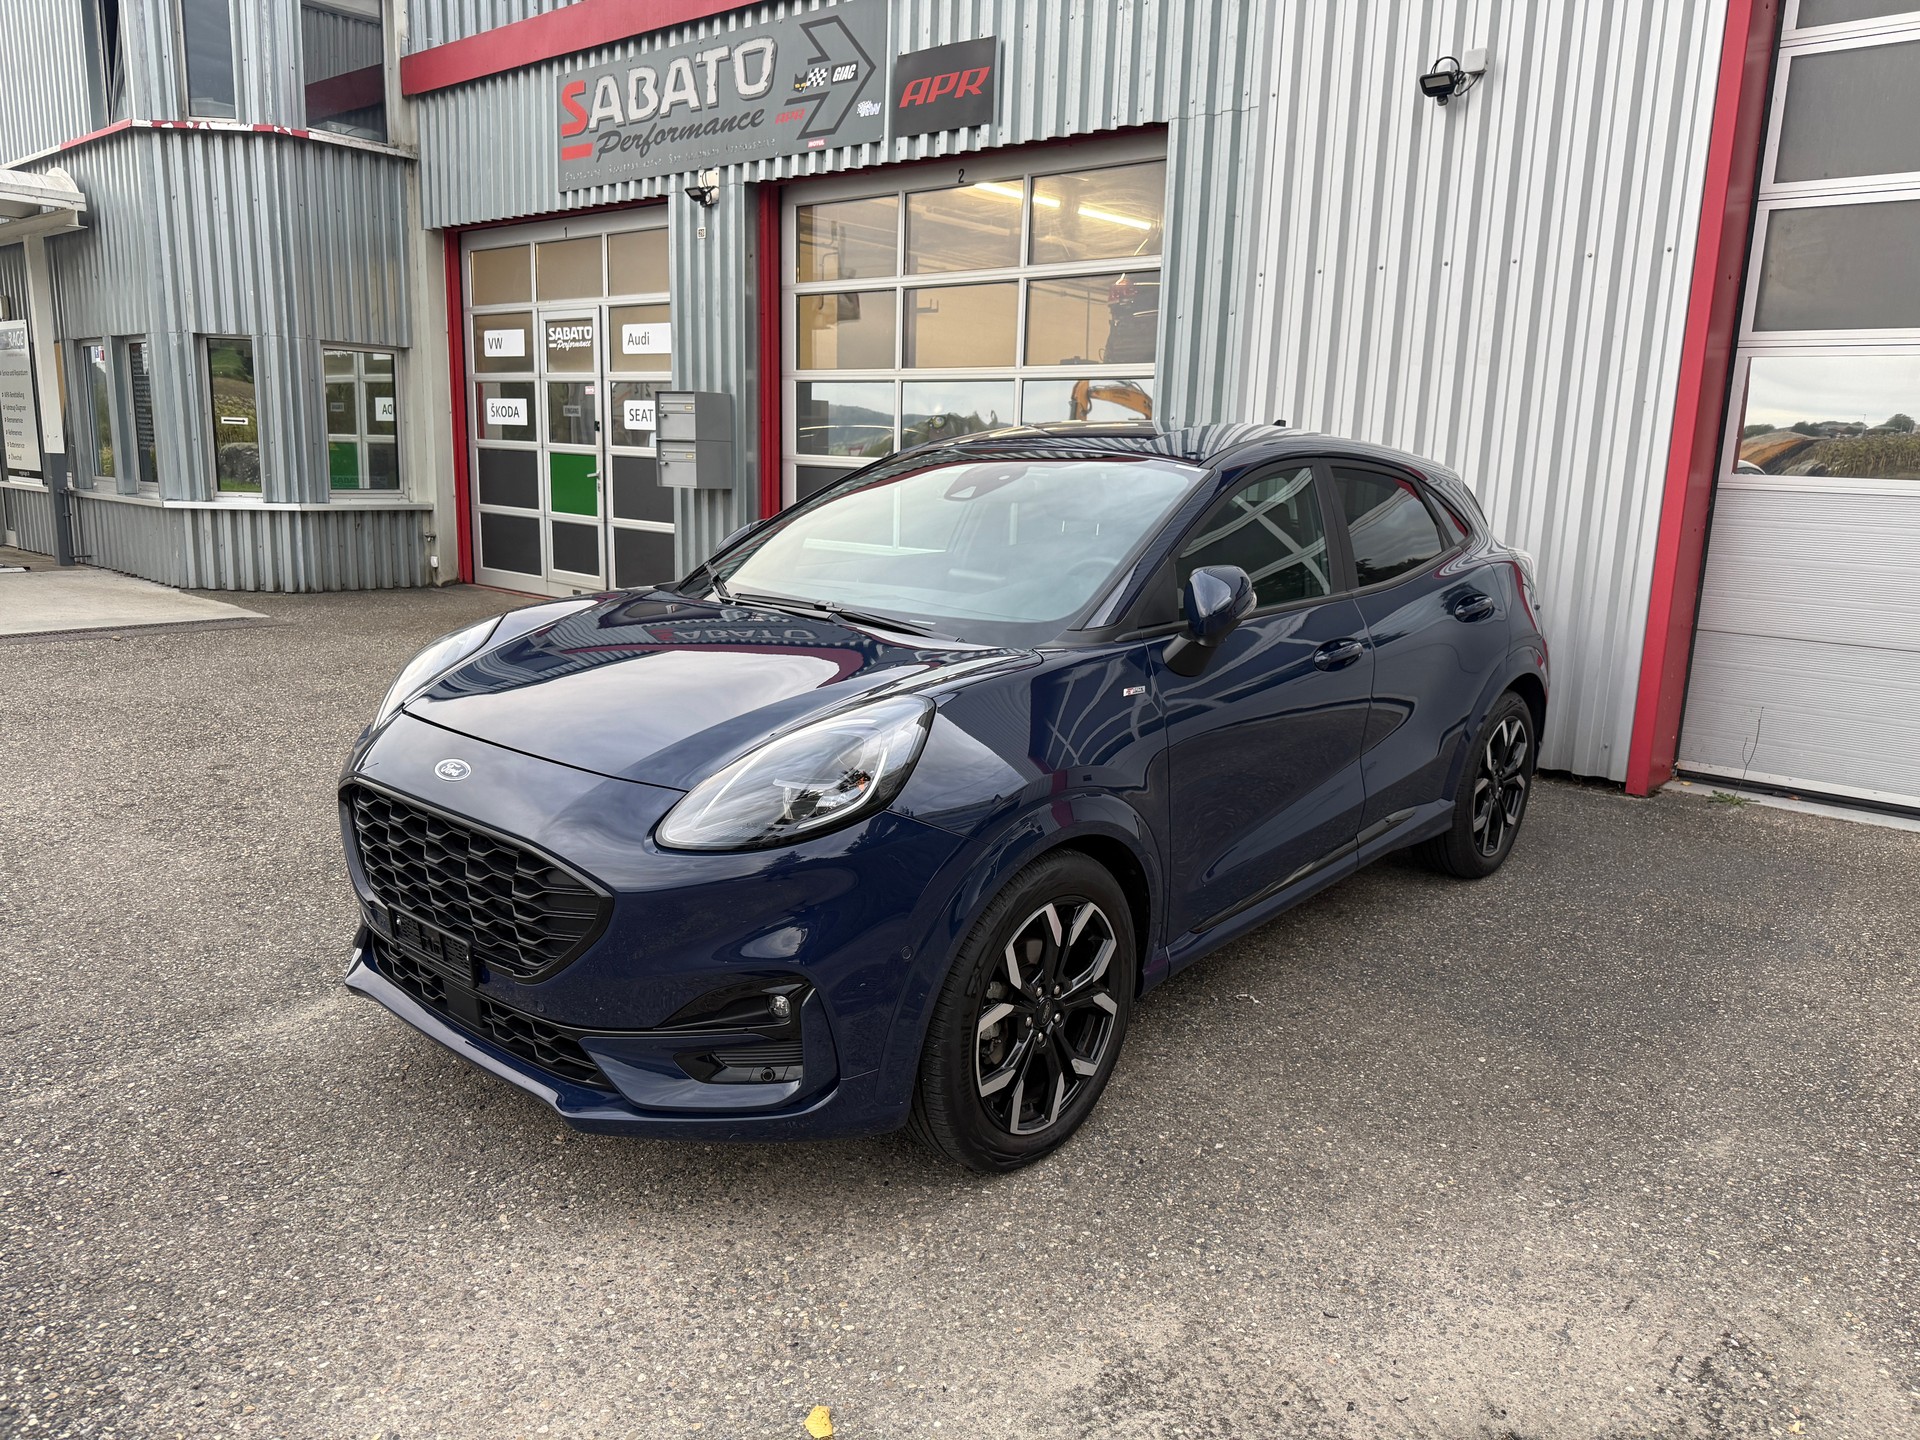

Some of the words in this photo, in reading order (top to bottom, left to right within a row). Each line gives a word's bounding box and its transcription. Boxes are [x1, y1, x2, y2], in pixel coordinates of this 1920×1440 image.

[832, 63, 857, 82] GIAC
[561, 35, 776, 138] SABATO
[899, 66, 990, 108] APR
[596, 108, 764, 162] Performance
[958, 168, 965, 183] 2
[548, 326, 592, 340] SABATO
[627, 332, 650, 346] Audi
[488, 337, 503, 350] VW
[556, 340, 592, 351] Performance
[490, 403, 520, 418] ŠKODA
[629, 408, 653, 422] SEAT
